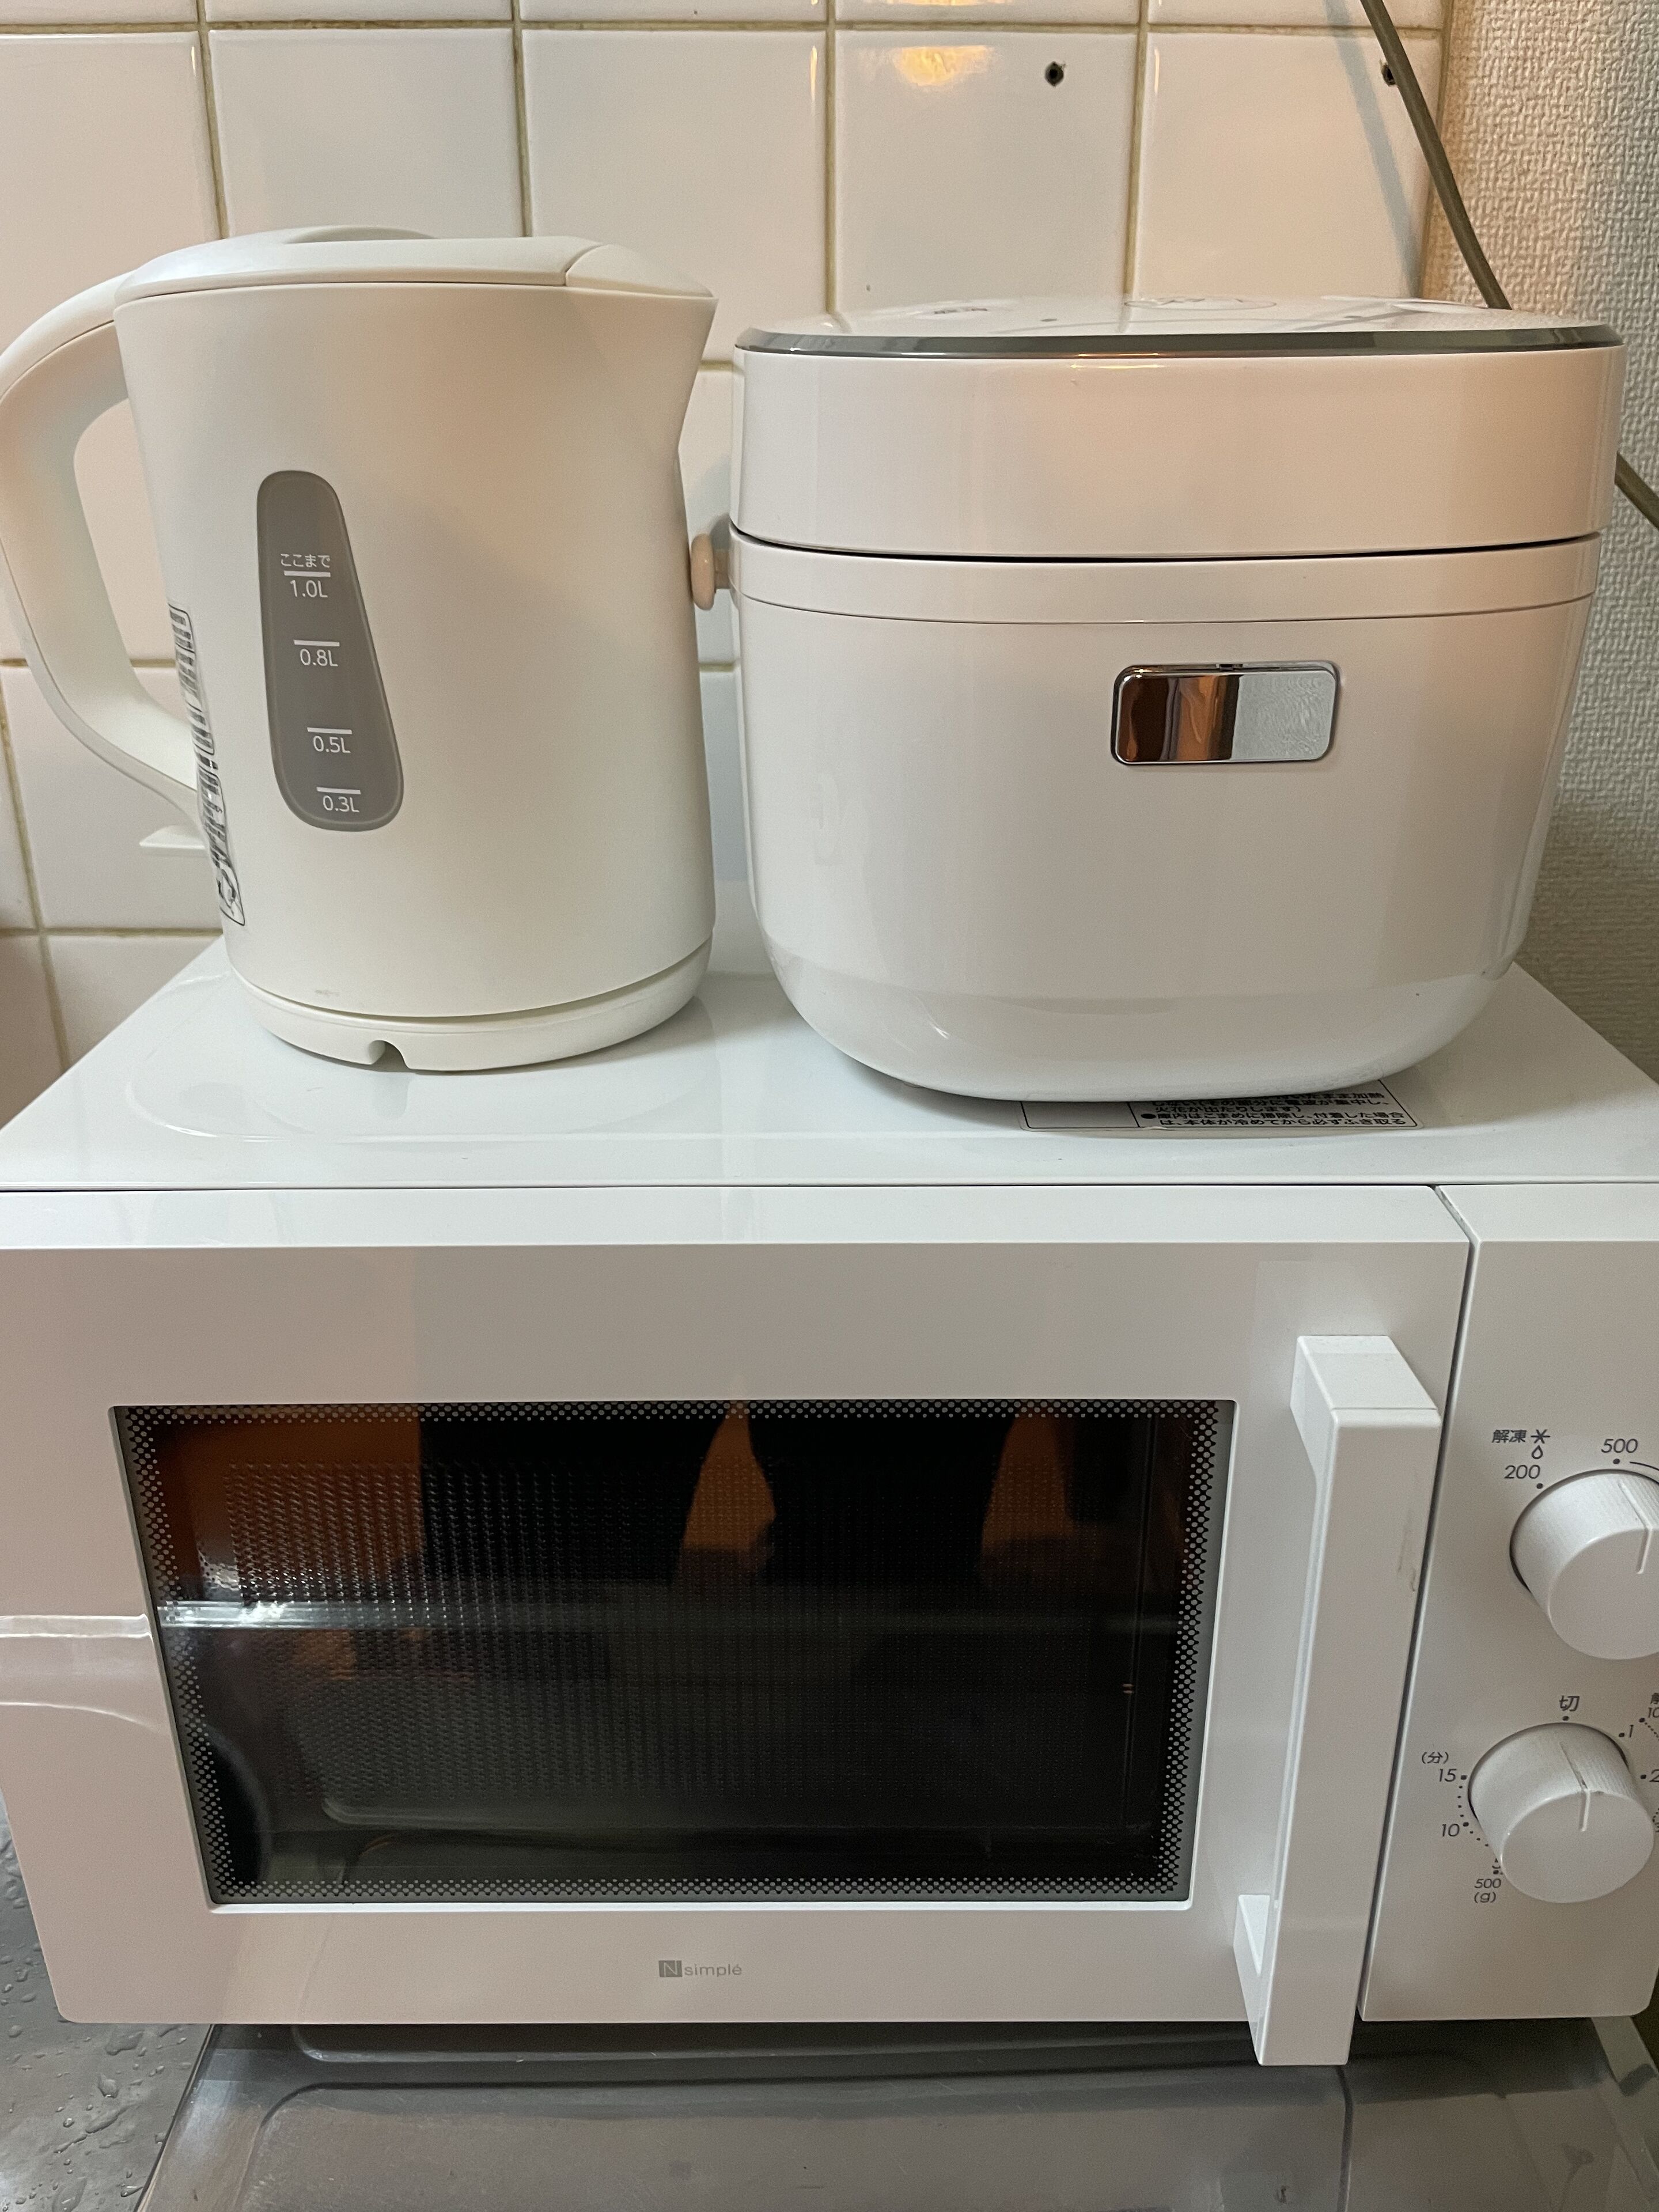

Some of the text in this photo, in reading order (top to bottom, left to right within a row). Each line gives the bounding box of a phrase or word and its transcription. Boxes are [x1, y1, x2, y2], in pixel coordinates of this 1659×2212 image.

[281, 554, 330, 567] ここまで
[290, 579, 328, 598] 1.0L
[300, 649, 338, 667] 0.8L
[313, 736, 351, 754] 0.5L
[323, 796, 360, 813] 0.3L
[1491, 1429, 1527, 1444] 解凍
[1601, 1438, 1638, 1453] 500
[1504, 1464, 1540, 1479] 200
[1559, 1695, 1580, 1712] 切
[1421, 1751, 1449, 1764] (分)
[1440, 1768, 1457, 1782] 15
[1441, 1823, 1460, 1837] 10
[1474, 1878, 1502, 1889] 500
[1474, 1892, 1497, 1903] (g)
